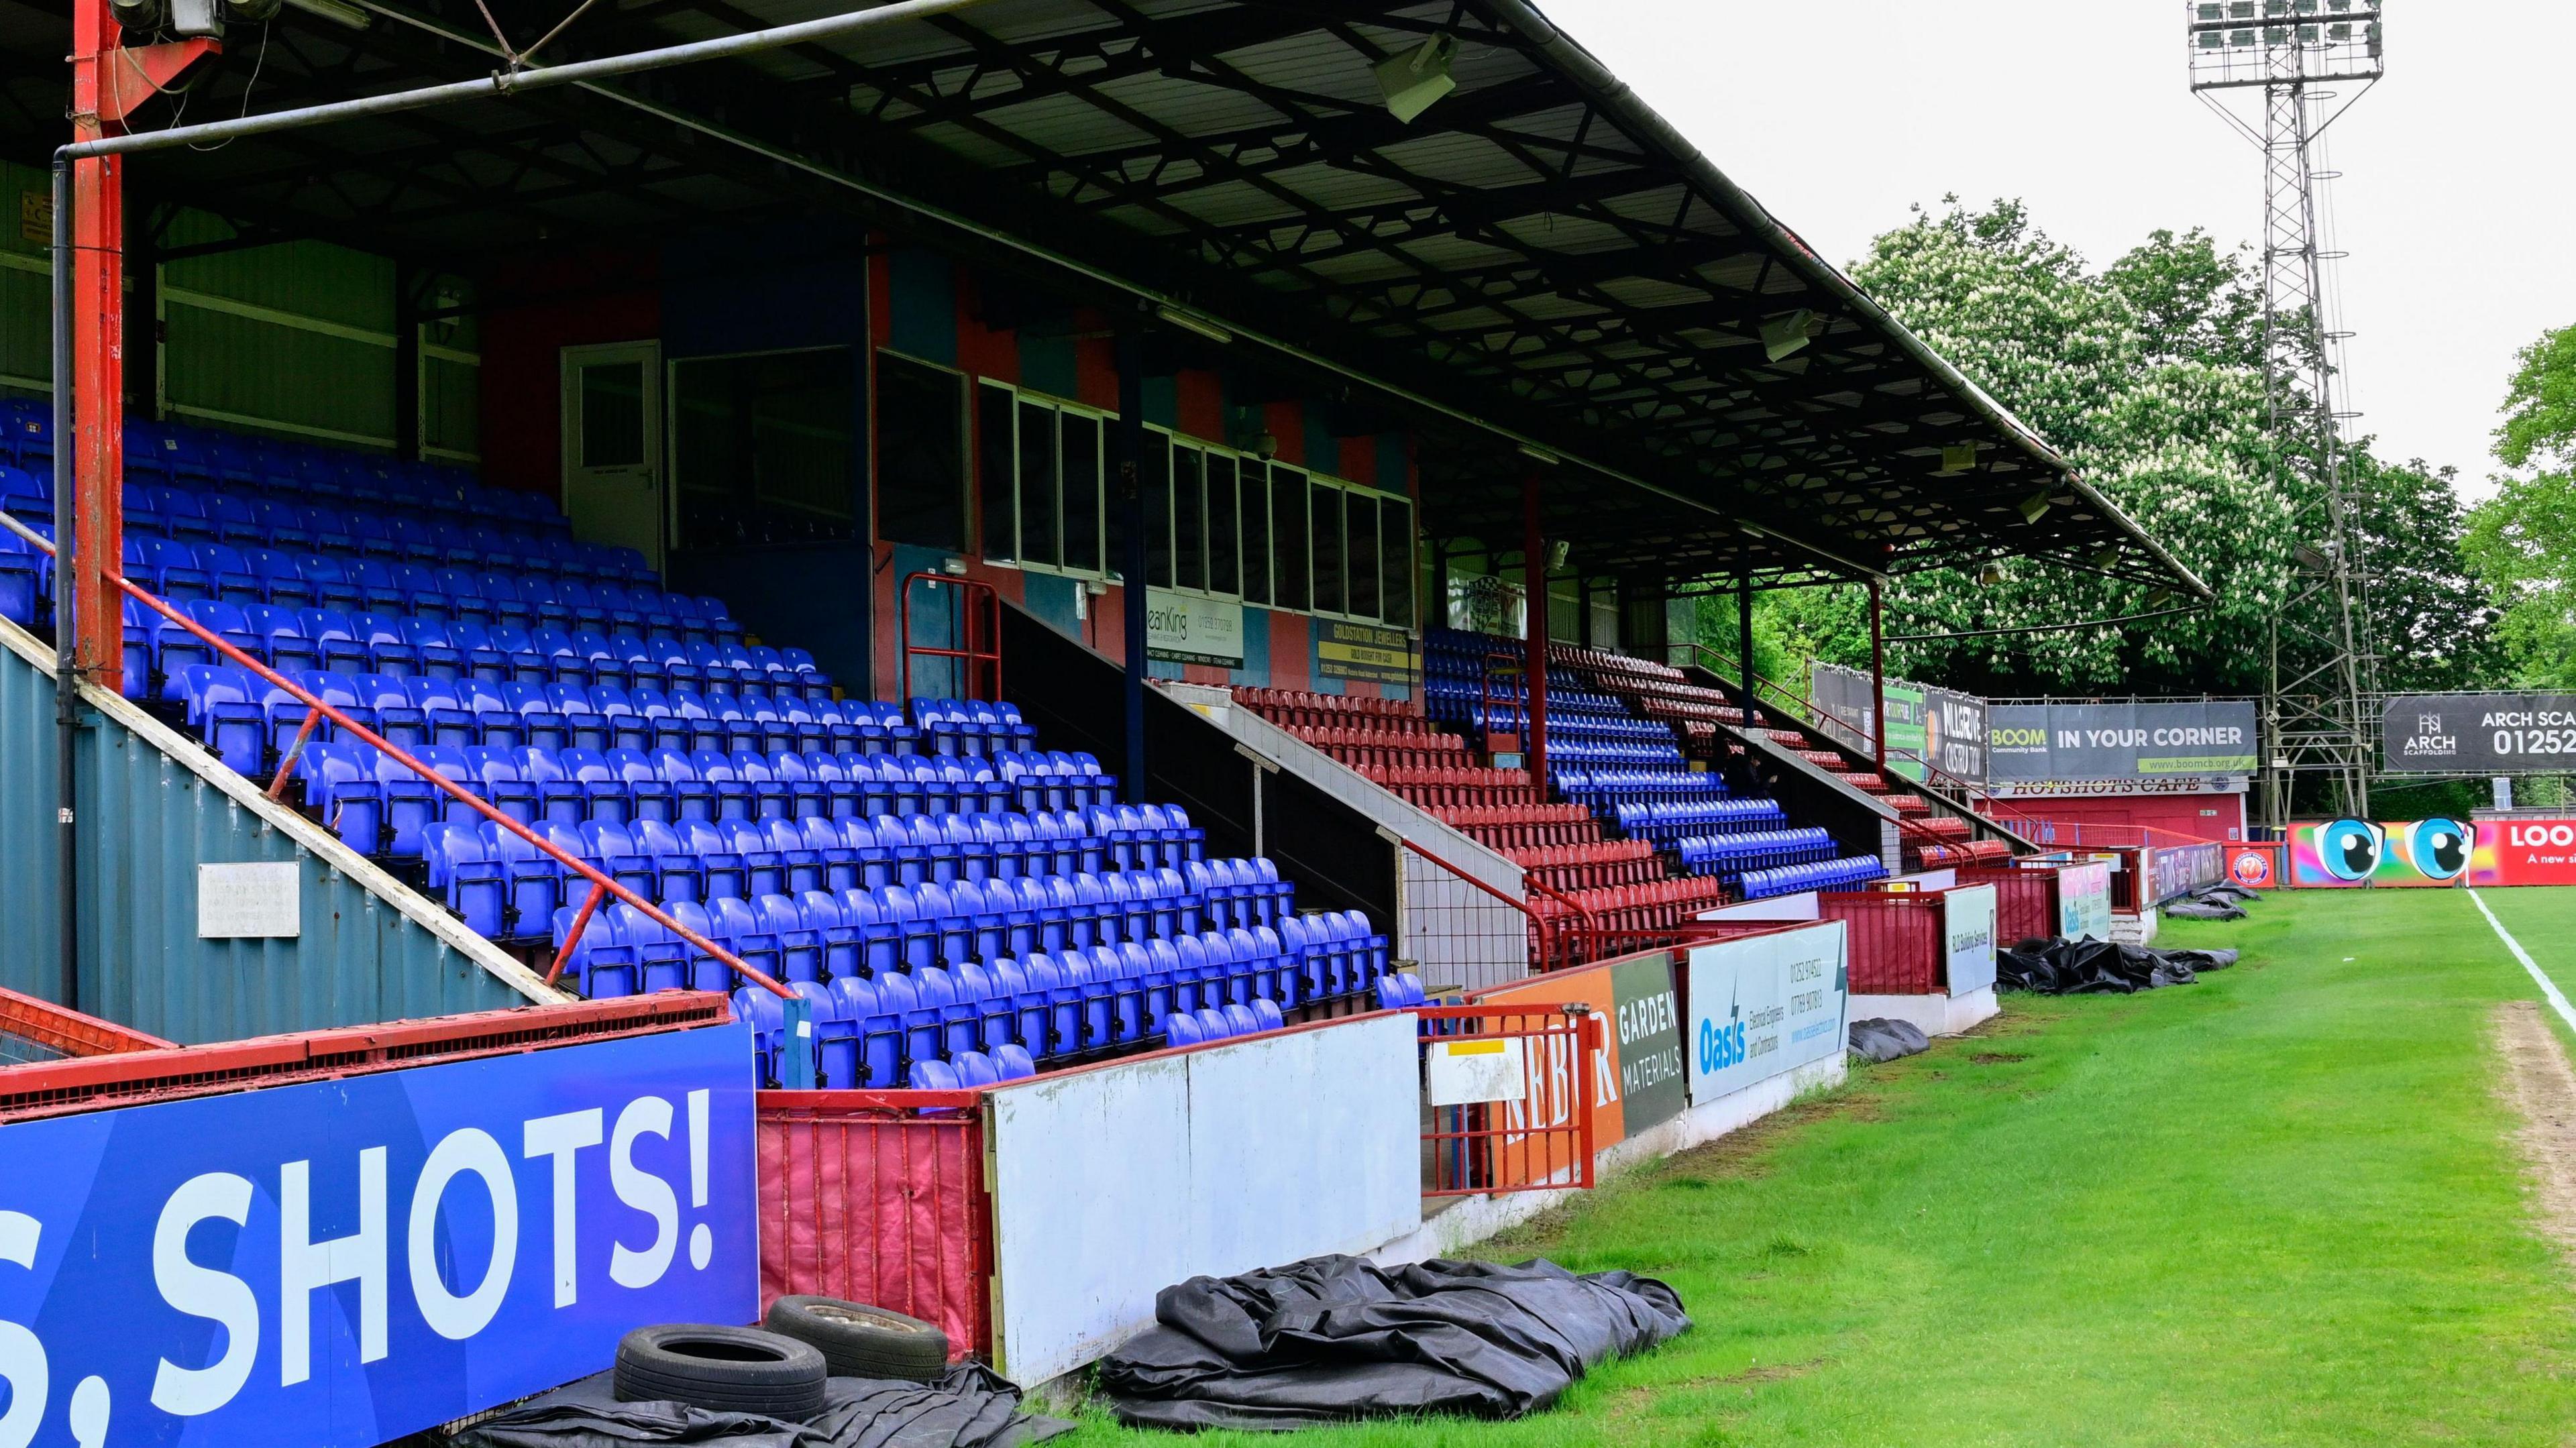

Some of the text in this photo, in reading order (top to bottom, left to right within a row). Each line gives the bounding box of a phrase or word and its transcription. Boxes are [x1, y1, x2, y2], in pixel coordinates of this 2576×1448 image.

[1334, 624, 1407, 647] GOLDSTATION JEWELLERS
[1351, 649, 1359, 659] GOLD
[1360, 650, 1374, 661] BOUGHT
[1383, 653, 1392, 663] CASH
[2481, 711, 2576, 726] ARCH SCA
[2058, 726, 2241, 748] IN YOUR CORNER
[2404, 736, 2455, 749] ARCH
[2494, 729, 2576, 755] 01252
[2149, 758, 2245, 770] www.boomcb.org.uk
[2012, 778, 2201, 794] HOTSHOTS CAFE
[2511, 825, 2576, 846] LOO
[2527, 853, 2537, 864] A
[2541, 856, 2565, 864] new
[1790, 962, 1805, 983] 01252
[1791, 993, 1805, 1016] 07769
[1619, 990, 1676, 1045] GARDEN
[1750, 1005, 1784, 1031] Electrical Engineers
[1700, 1017, 1746, 1075] Oasis
[1750, 1034, 1778, 1059] and Contractors
[1623, 1046, 1681, 1096] MATERIALS
[151, 1089, 713, 1416] SHOTS!
